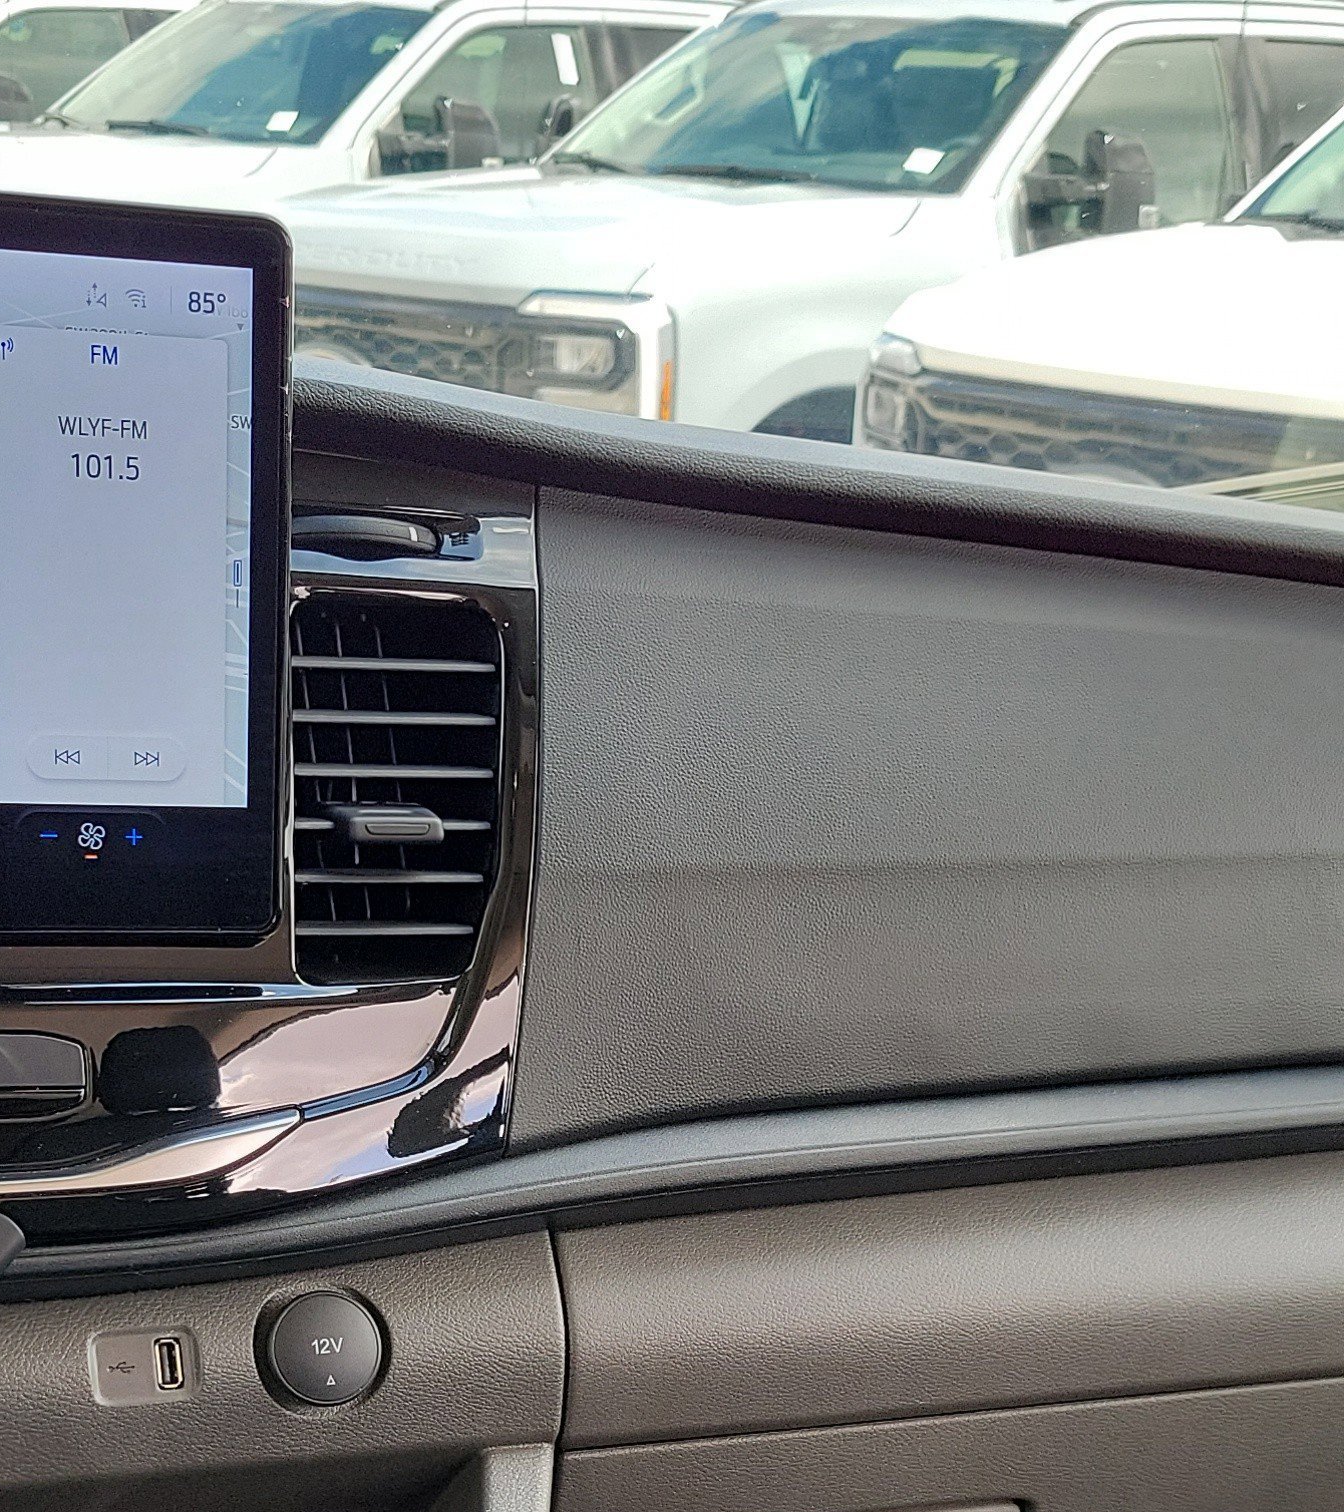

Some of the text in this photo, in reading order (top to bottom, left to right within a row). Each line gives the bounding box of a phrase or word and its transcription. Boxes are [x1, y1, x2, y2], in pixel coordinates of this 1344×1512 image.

[188, 291, 227, 314] 85°
[90, 344, 119, 366] FM
[58, 416, 148, 440] WLYF-FM
[70, 453, 140, 481] 101.5
[311, 1337, 344, 1355] 12V
